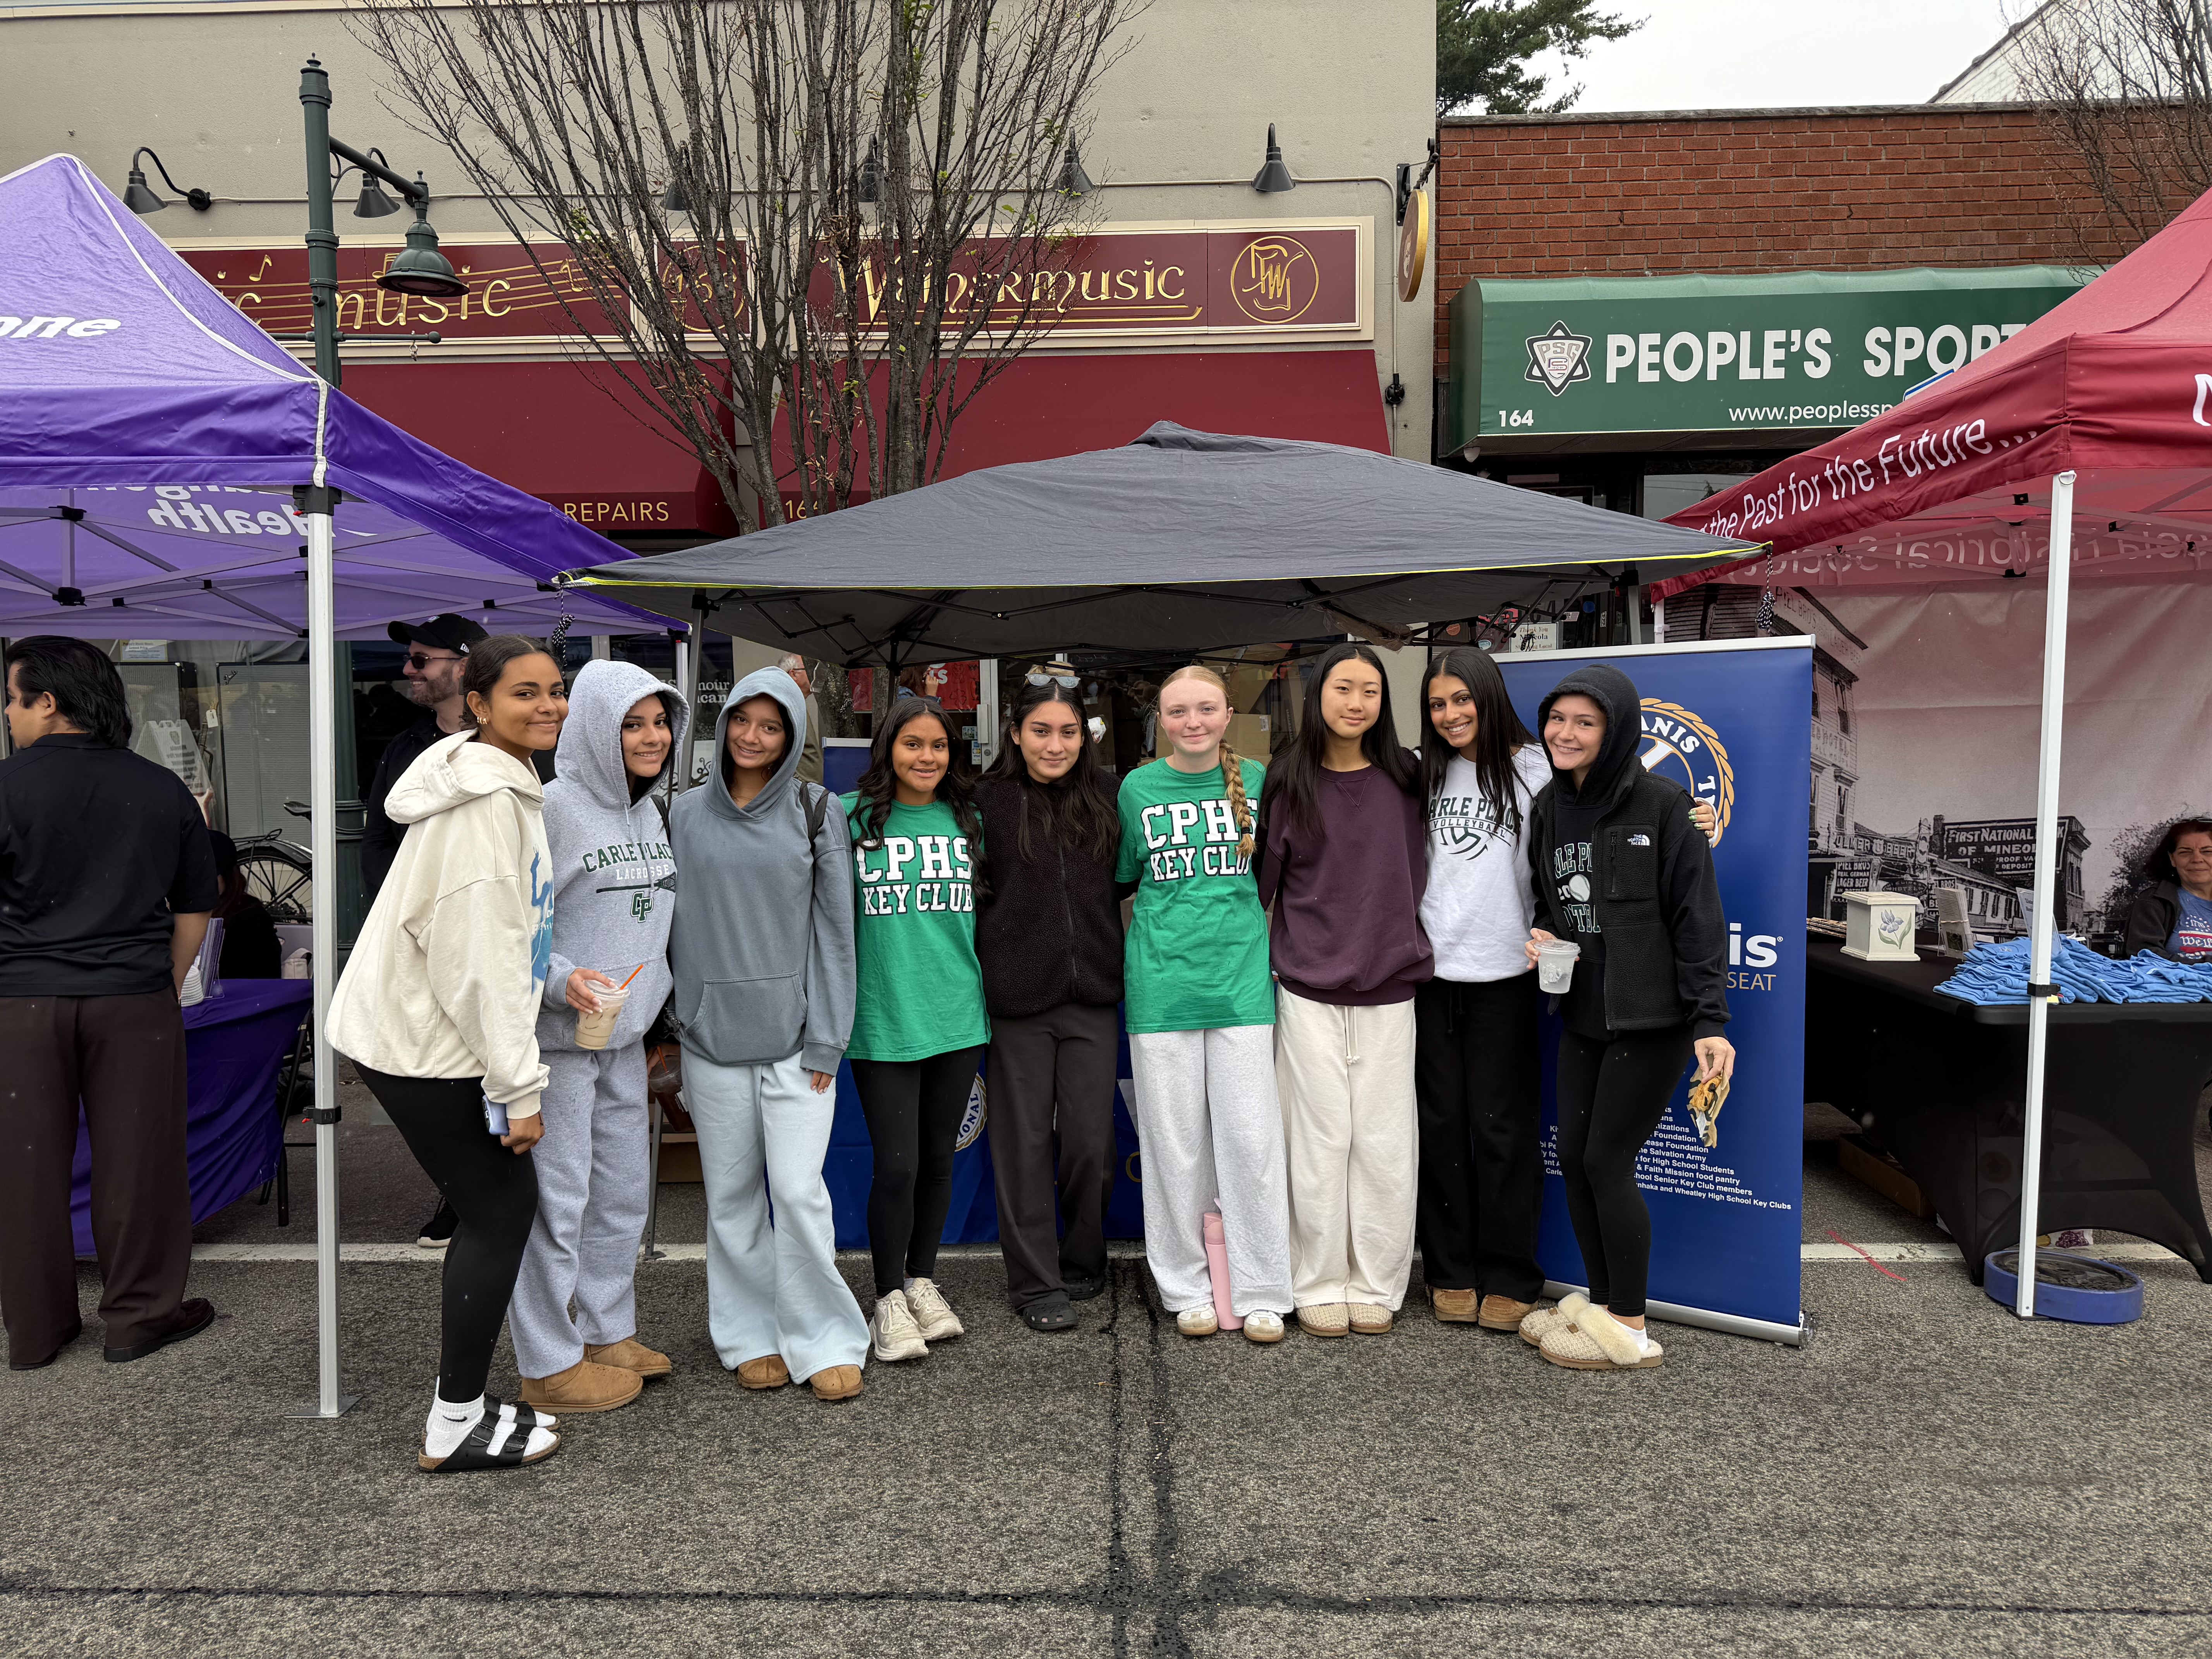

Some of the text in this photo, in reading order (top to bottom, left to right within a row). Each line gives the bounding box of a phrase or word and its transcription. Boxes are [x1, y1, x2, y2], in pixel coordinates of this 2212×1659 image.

[1537, 342, 1581, 364] PSG
[1606, 328, 1832, 383] PEOPLE'S
[1499, 409, 1534, 427] 164
[1738, 483, 1785, 535] Past
[1789, 472, 1819, 515] for
[1824, 455, 1874, 500] the
[564, 502, 669, 522] REPAIRS
[1948, 828, 2034, 843] FIRST NATIONAL
[582, 842, 674, 873] CARLE PLAC
[855, 835, 974, 883] CPHS
[1958, 846, 1977, 856] OF
[616, 864, 670, 881] LACROSSE
[1149, 845, 1252, 883] KEY CLU
[1837, 878, 1869, 887] LAGER BEER
[1941, 880, 1955, 888] BROS
[862, 882, 974, 915] KEY CLUB
[1726, 972, 1777, 991] SEAT
[1654, 1131, 1697, 1143] Foundation
[1649, 1147, 1685, 1159] Salvation
[1686, 1153, 1706, 1163] Army
[1666, 1141, 1709, 1153] Foundation
[1644, 1165, 1663, 1174] Faith
[1665, 1168, 1694, 1178] Mission
[1696, 1172, 1714, 1181] food
[1715, 1176, 1740, 1186] pantry
[1652, 1157, 1670, 1166] High
[1672, 1159, 1698, 1170] School
[1700, 1164, 1735, 1175] Students
[1546, 1168, 1563, 1176] Carle
[1636, 1182, 1658, 1190] nhaka
[1674, 1187, 1706, 1199] Wheatley
[1708, 1192, 1724, 1201] High
[1726, 1195, 1751, 1205] School
[1753, 1199, 1767, 1208] Key
[1769, 1201, 1791, 1210] Clubs
[1654, 1175, 1679, 1185] Senior
[1680, 1178, 1695, 1188] Key
[1697, 1181, 1714, 1190] Club
[1716, 1185, 1753, 1196] members
